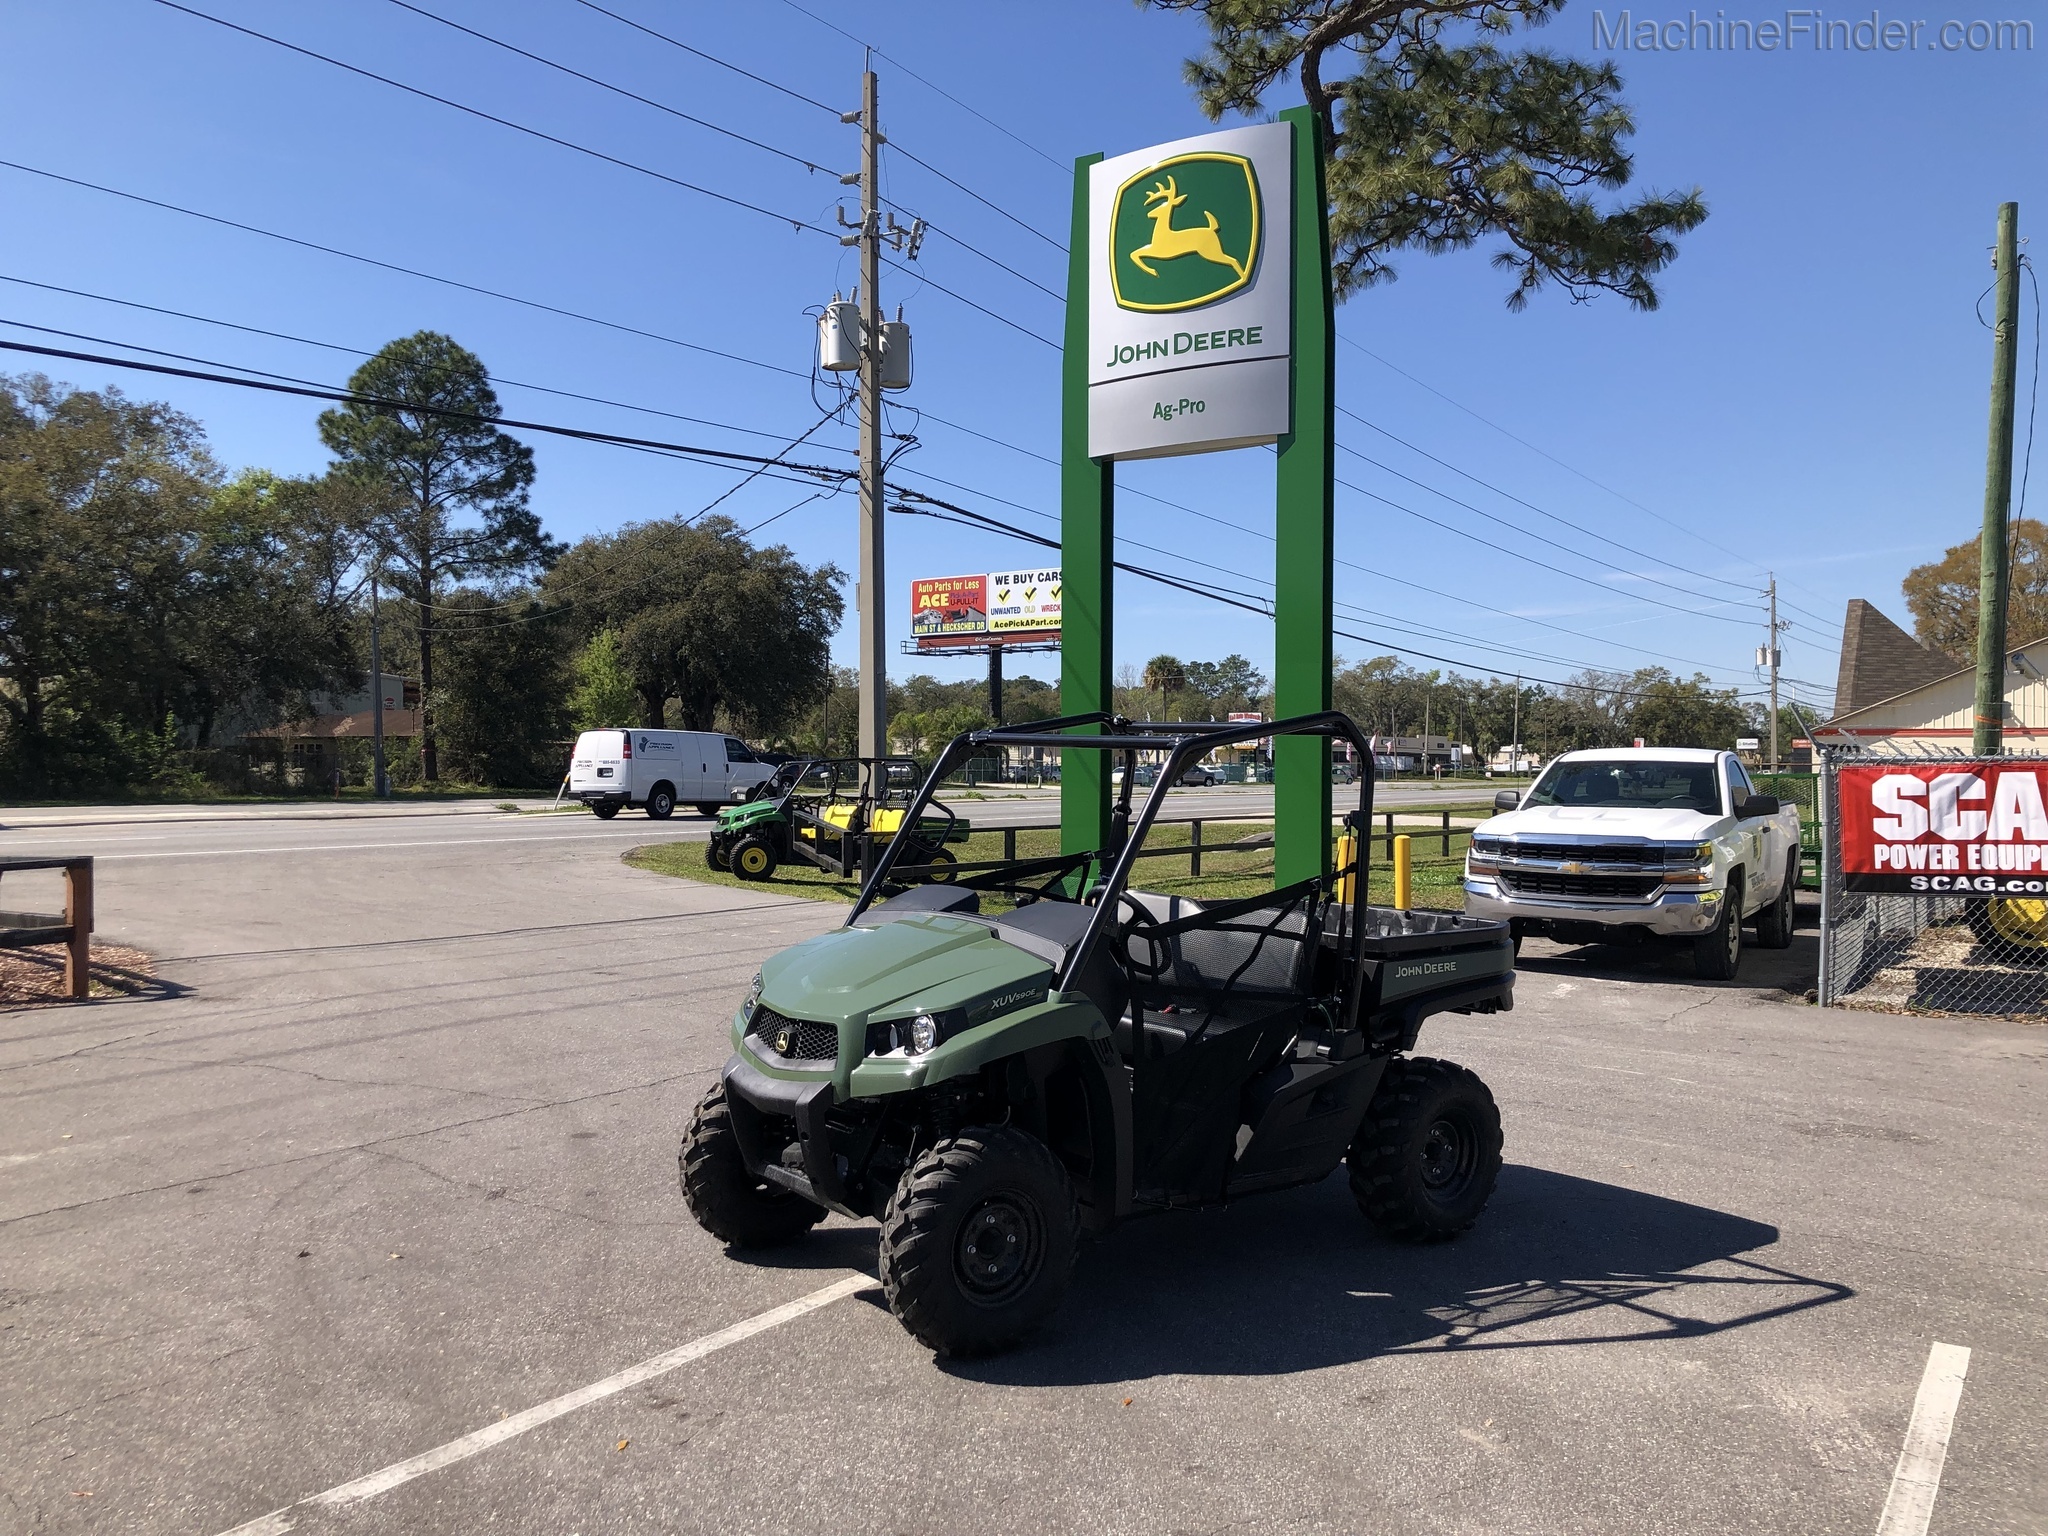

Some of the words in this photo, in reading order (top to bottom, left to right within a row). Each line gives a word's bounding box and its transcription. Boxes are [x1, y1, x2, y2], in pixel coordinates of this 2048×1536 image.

[1106, 338, 1169, 368] JOHN
[1173, 325, 1263, 356] DEERE
[1152, 398, 1206, 420] Ag-Pro
[918, 583, 933, 593] Auto
[934, 581, 952, 592] Parts
[953, 580, 963, 590] for
[964, 579, 980, 589] Less
[995, 575, 1010, 586] WE
[1013, 573, 1034, 584] BUY
[919, 593, 950, 608] ACE
[950, 597, 979, 606] U-PULL-IT
[990, 606, 1021, 616] UNWANTED
[1024, 605, 1036, 613] OLD
[914, 625, 928, 634] MAIN
[928, 624, 937, 633] ST
[937, 623, 942, 632] &
[976, 621, 985, 630] DR
[1871, 772, 2048, 841] SCA
[1874, 843, 1960, 870] POWER
[1910, 875, 2048, 893] SCAG.co
[1395, 966, 1423, 979] JOHN
[1423, 961, 1457, 975] DEERE
